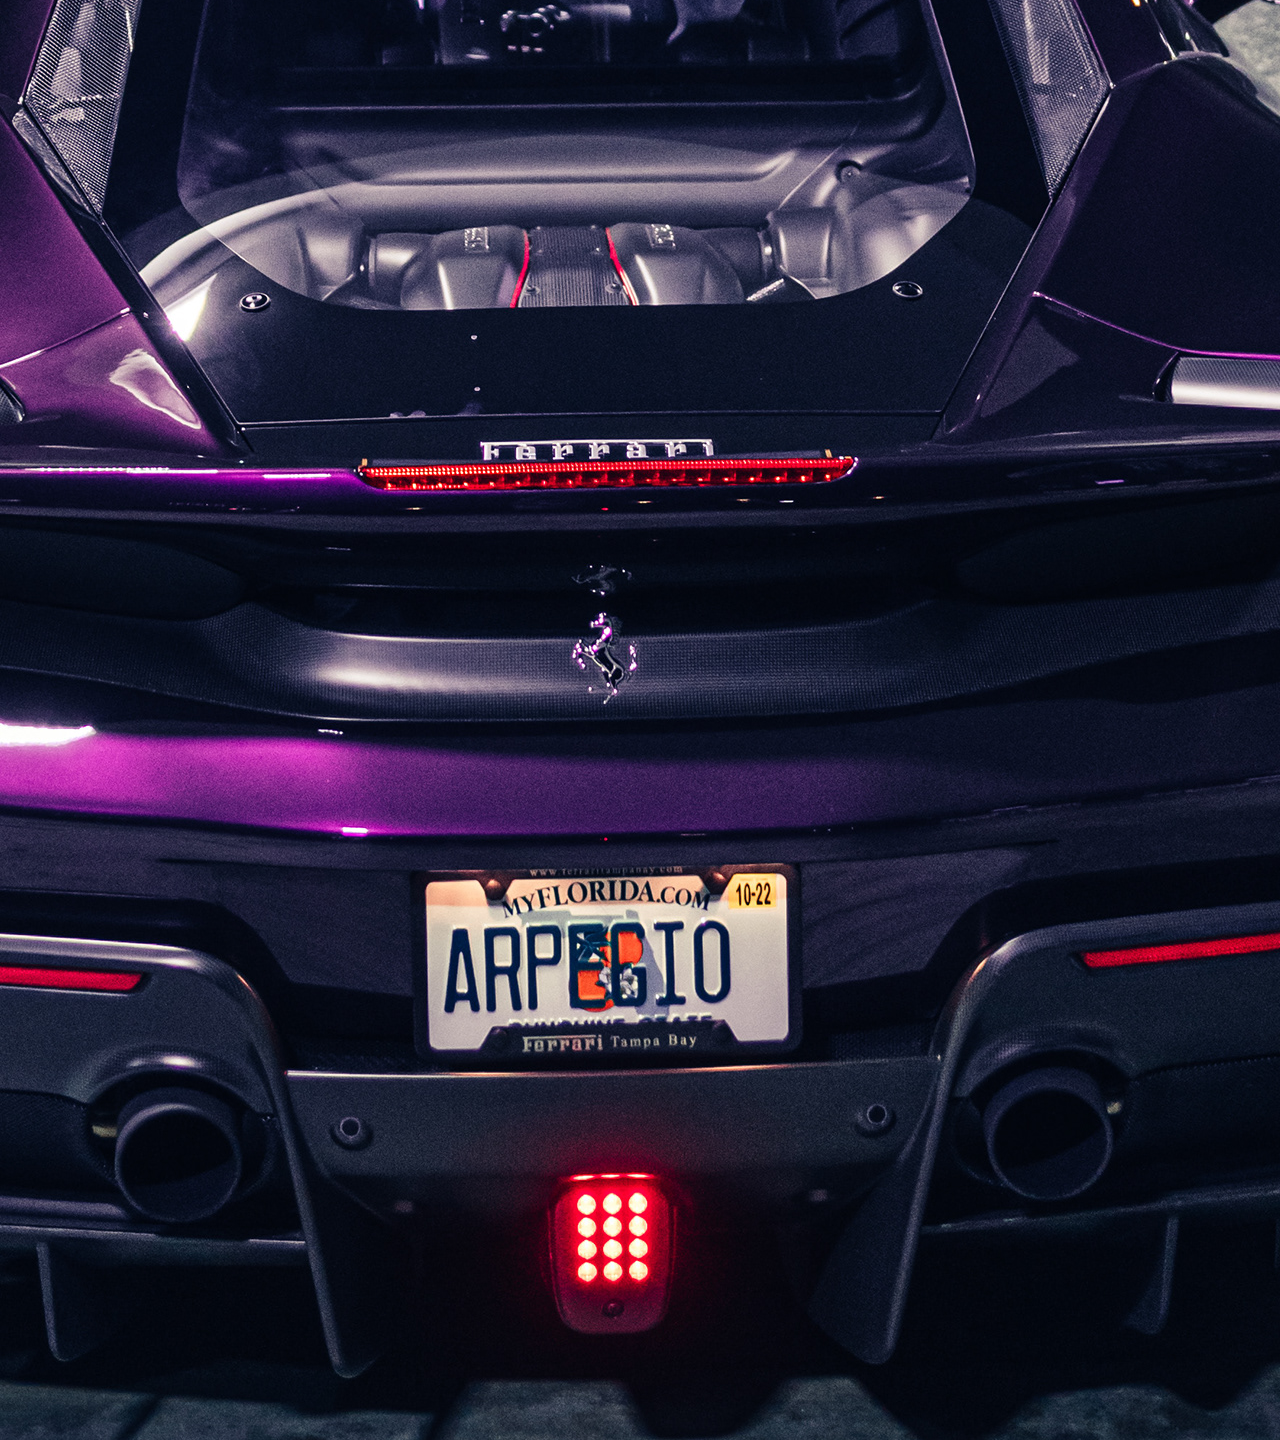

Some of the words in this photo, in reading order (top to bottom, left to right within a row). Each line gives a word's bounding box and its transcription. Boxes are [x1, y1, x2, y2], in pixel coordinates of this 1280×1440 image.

[479, 438, 715, 461] Ferrari
[501, 879, 711, 918] MYFLORIDA.COM
[735, 882, 772, 906] 10-22
[443, 919, 732, 1013] ARPEGIO
[522, 1034, 604, 1053] Ferrari
[609, 1035, 661, 1049] Tampa
[668, 1033, 698, 1048] Bay
